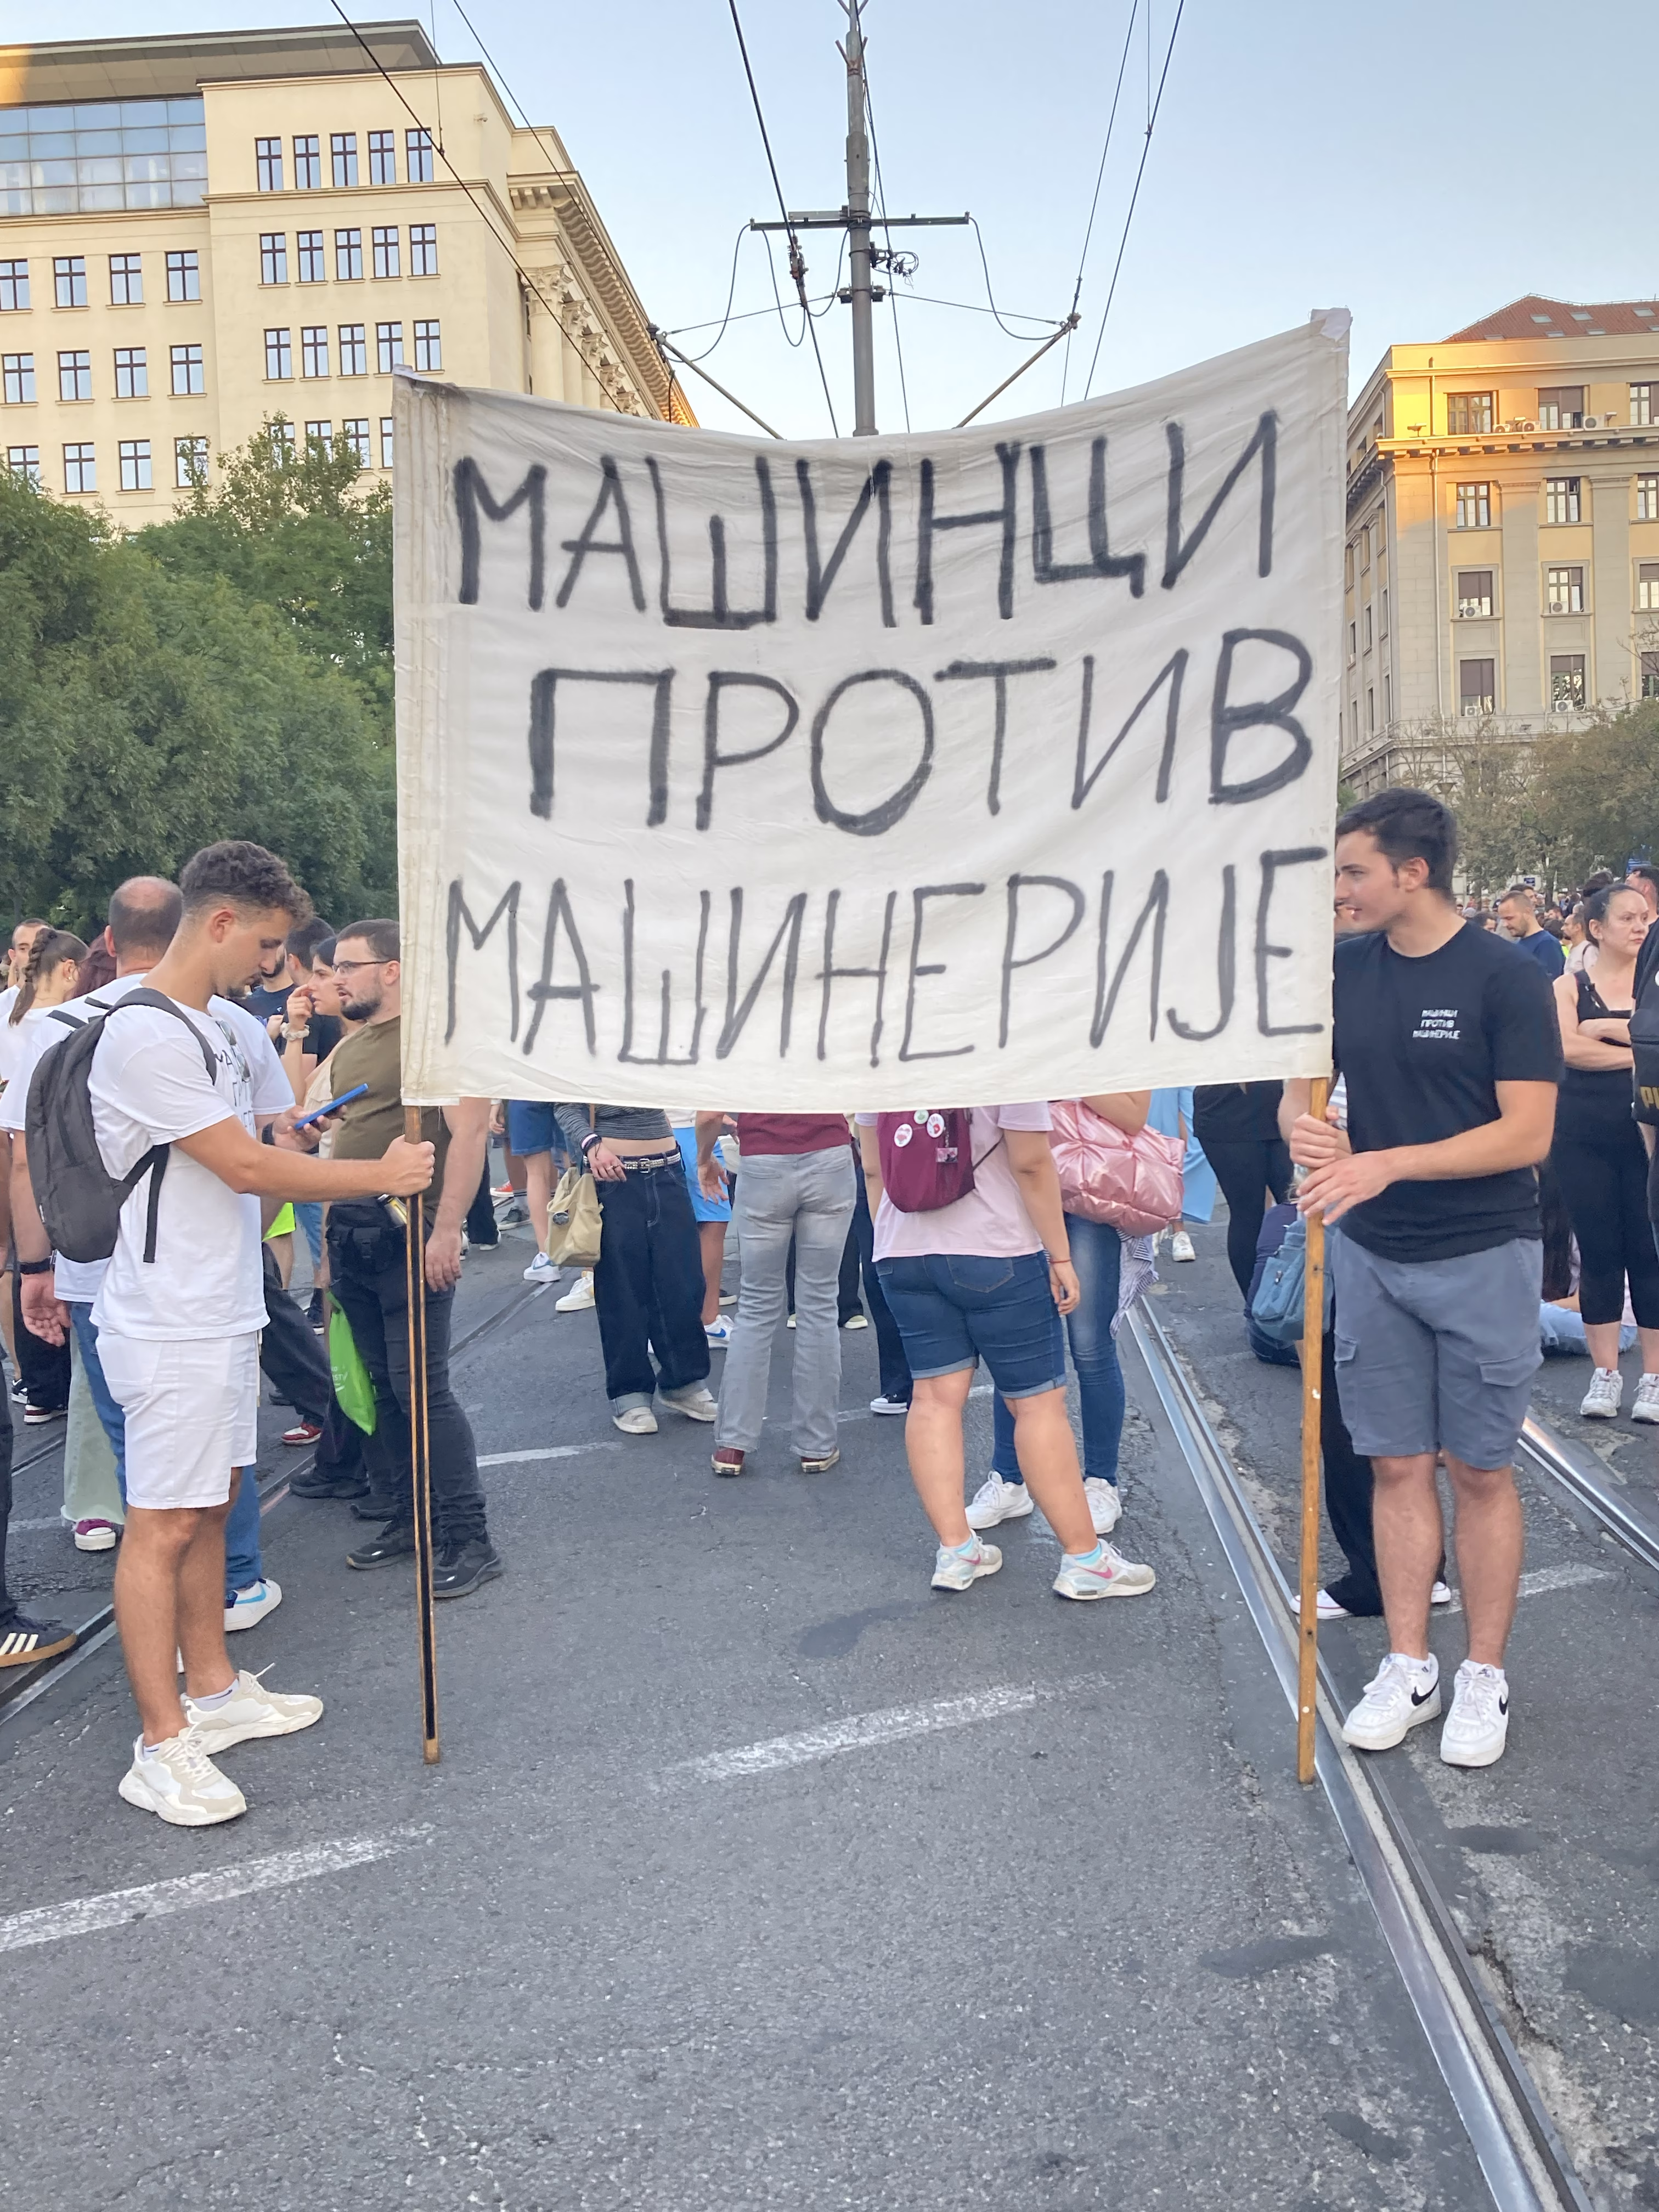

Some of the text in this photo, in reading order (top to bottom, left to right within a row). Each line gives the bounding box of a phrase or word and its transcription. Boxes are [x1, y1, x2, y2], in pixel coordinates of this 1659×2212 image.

[453, 409, 1278, 631] МАШИНЦИ
[529, 628, 1312, 837] ПРОТИВ
[444, 847, 1328, 1068] МАШИНЕРИЈЕ
